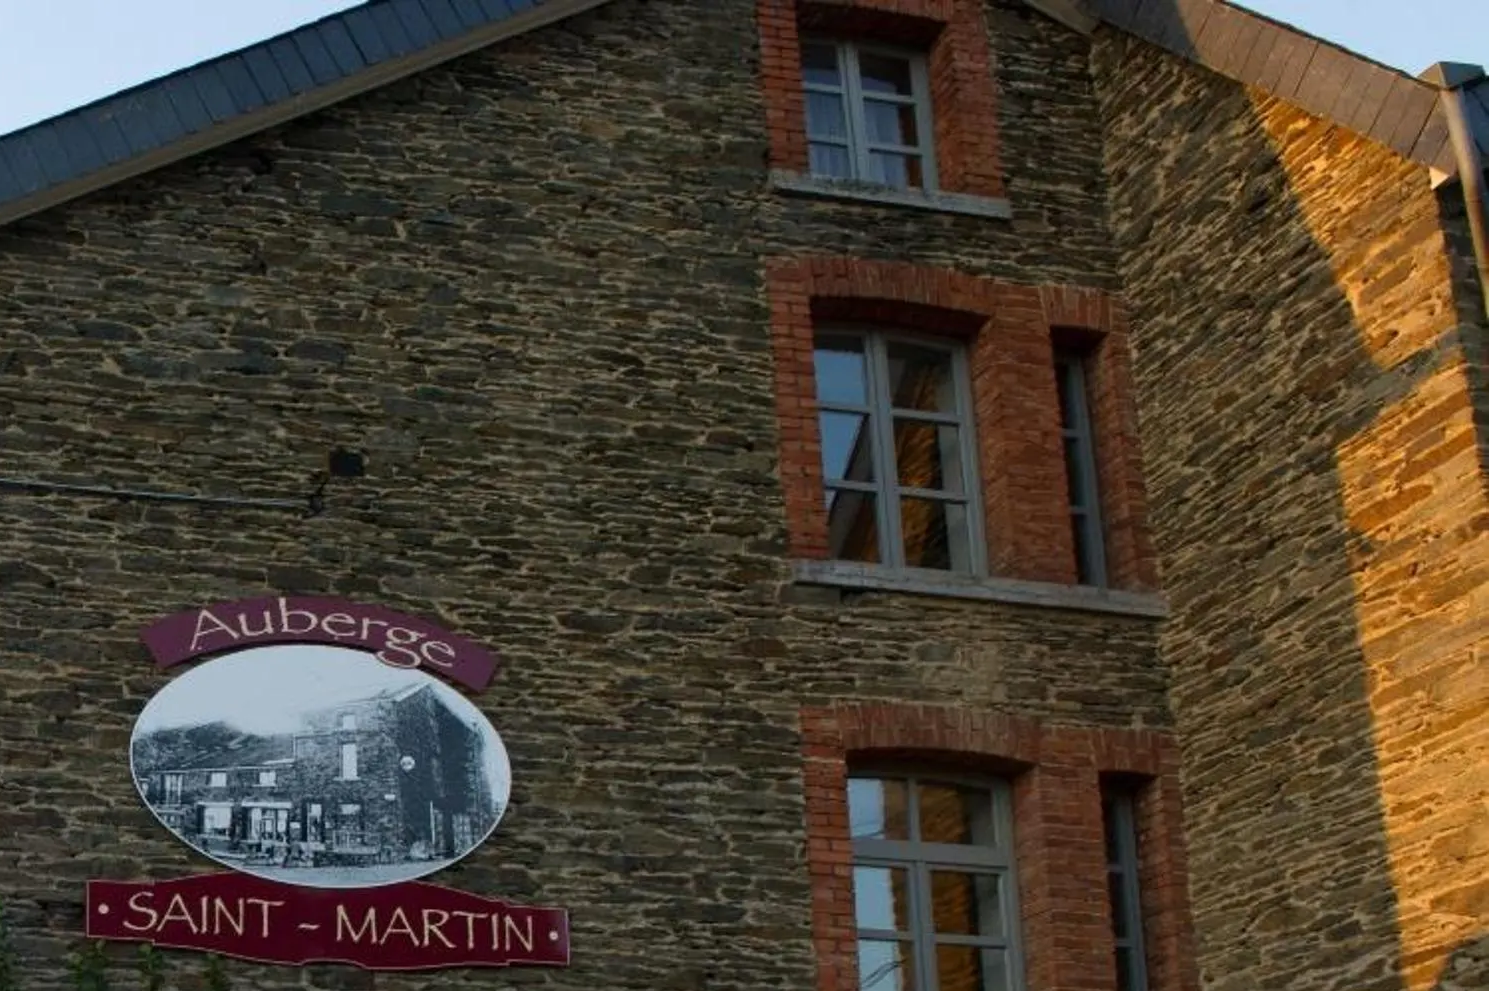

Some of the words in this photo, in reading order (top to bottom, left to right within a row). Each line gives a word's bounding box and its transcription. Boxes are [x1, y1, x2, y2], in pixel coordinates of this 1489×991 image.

[190, 597, 456, 669] Auberge
[122, 891, 285, 938] SAINT
[335, 904, 534, 952] MARTIN
